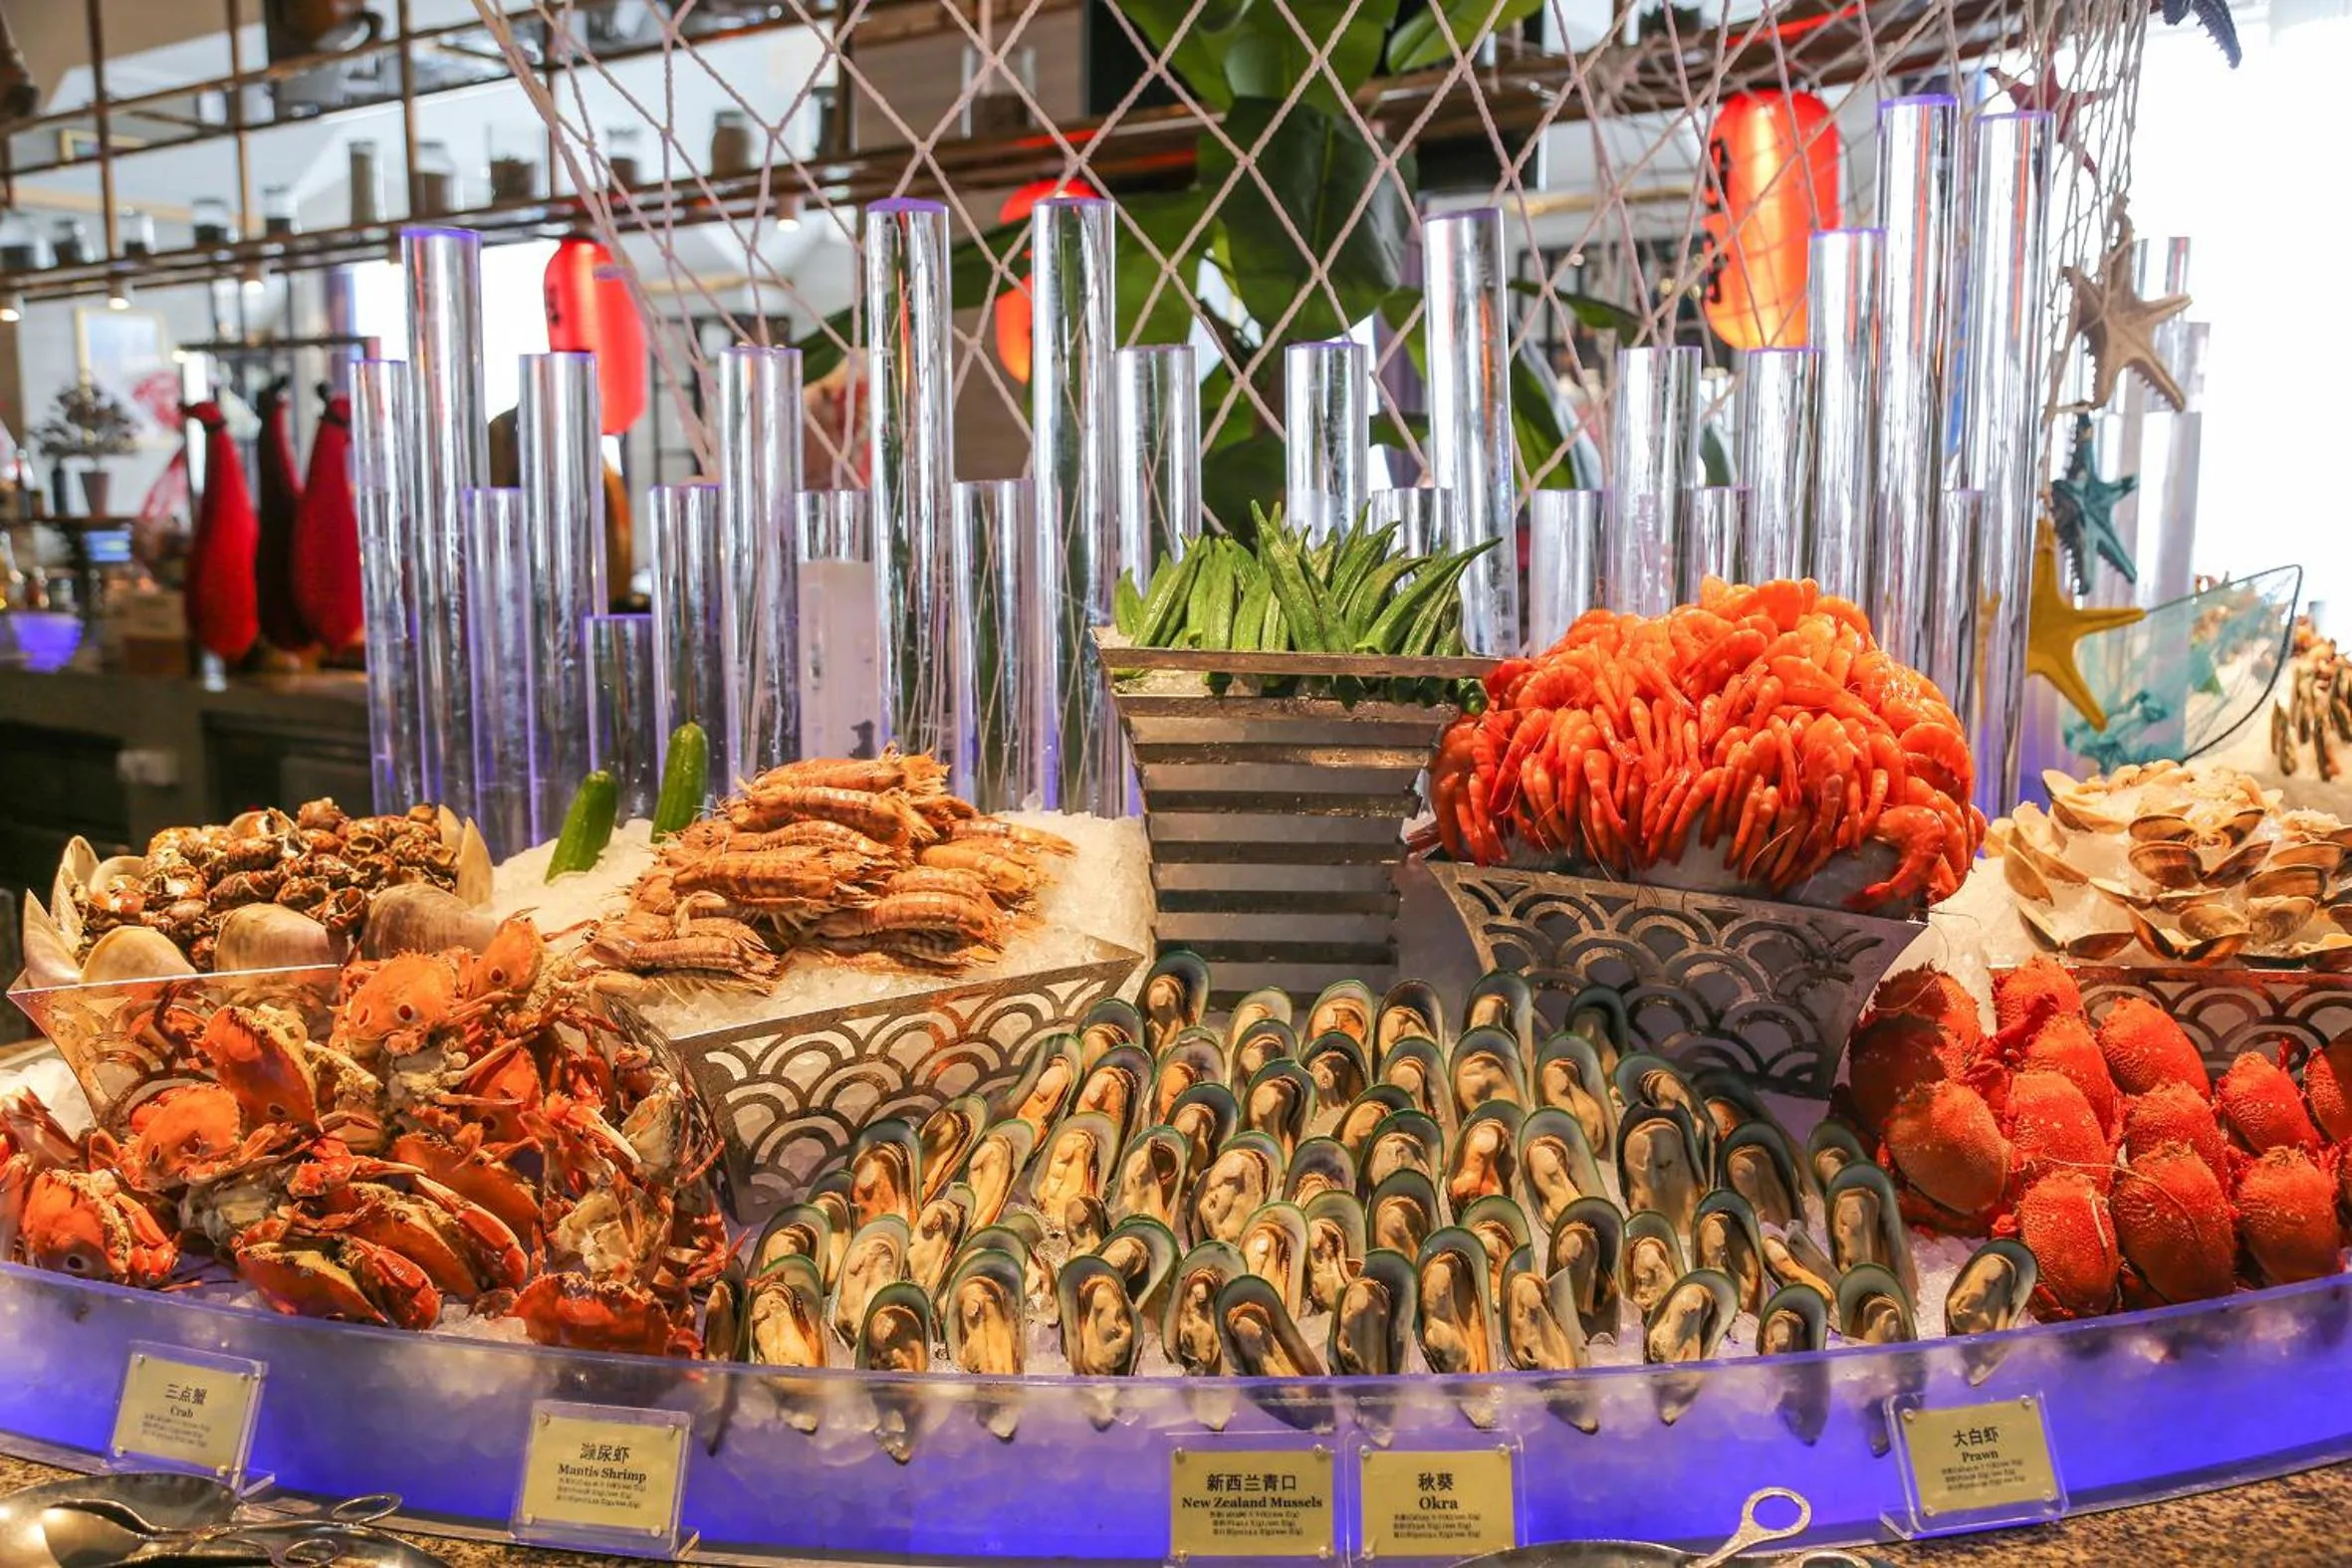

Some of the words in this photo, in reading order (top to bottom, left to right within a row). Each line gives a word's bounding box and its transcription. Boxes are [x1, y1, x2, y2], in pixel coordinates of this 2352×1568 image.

[164, 1383, 208, 1406] 三点蟹
[169, 1405, 194, 1419] Crab
[1953, 1426, 1999, 1448] 大白虾
[1962, 1451, 1999, 1462] Prawn
[558, 1462, 599, 1478] Mantis
[601, 1468, 647, 1484] Shrimp
[1207, 1473, 1296, 1492] 新西兰青口
[1418, 1472, 1454, 1491] 秋葵
[1182, 1496, 1212, 1509] New
[1214, 1496, 1267, 1508] Zealand
[1271, 1495, 1322, 1508] Mussels
[1419, 1496, 1459, 1510] Okra
